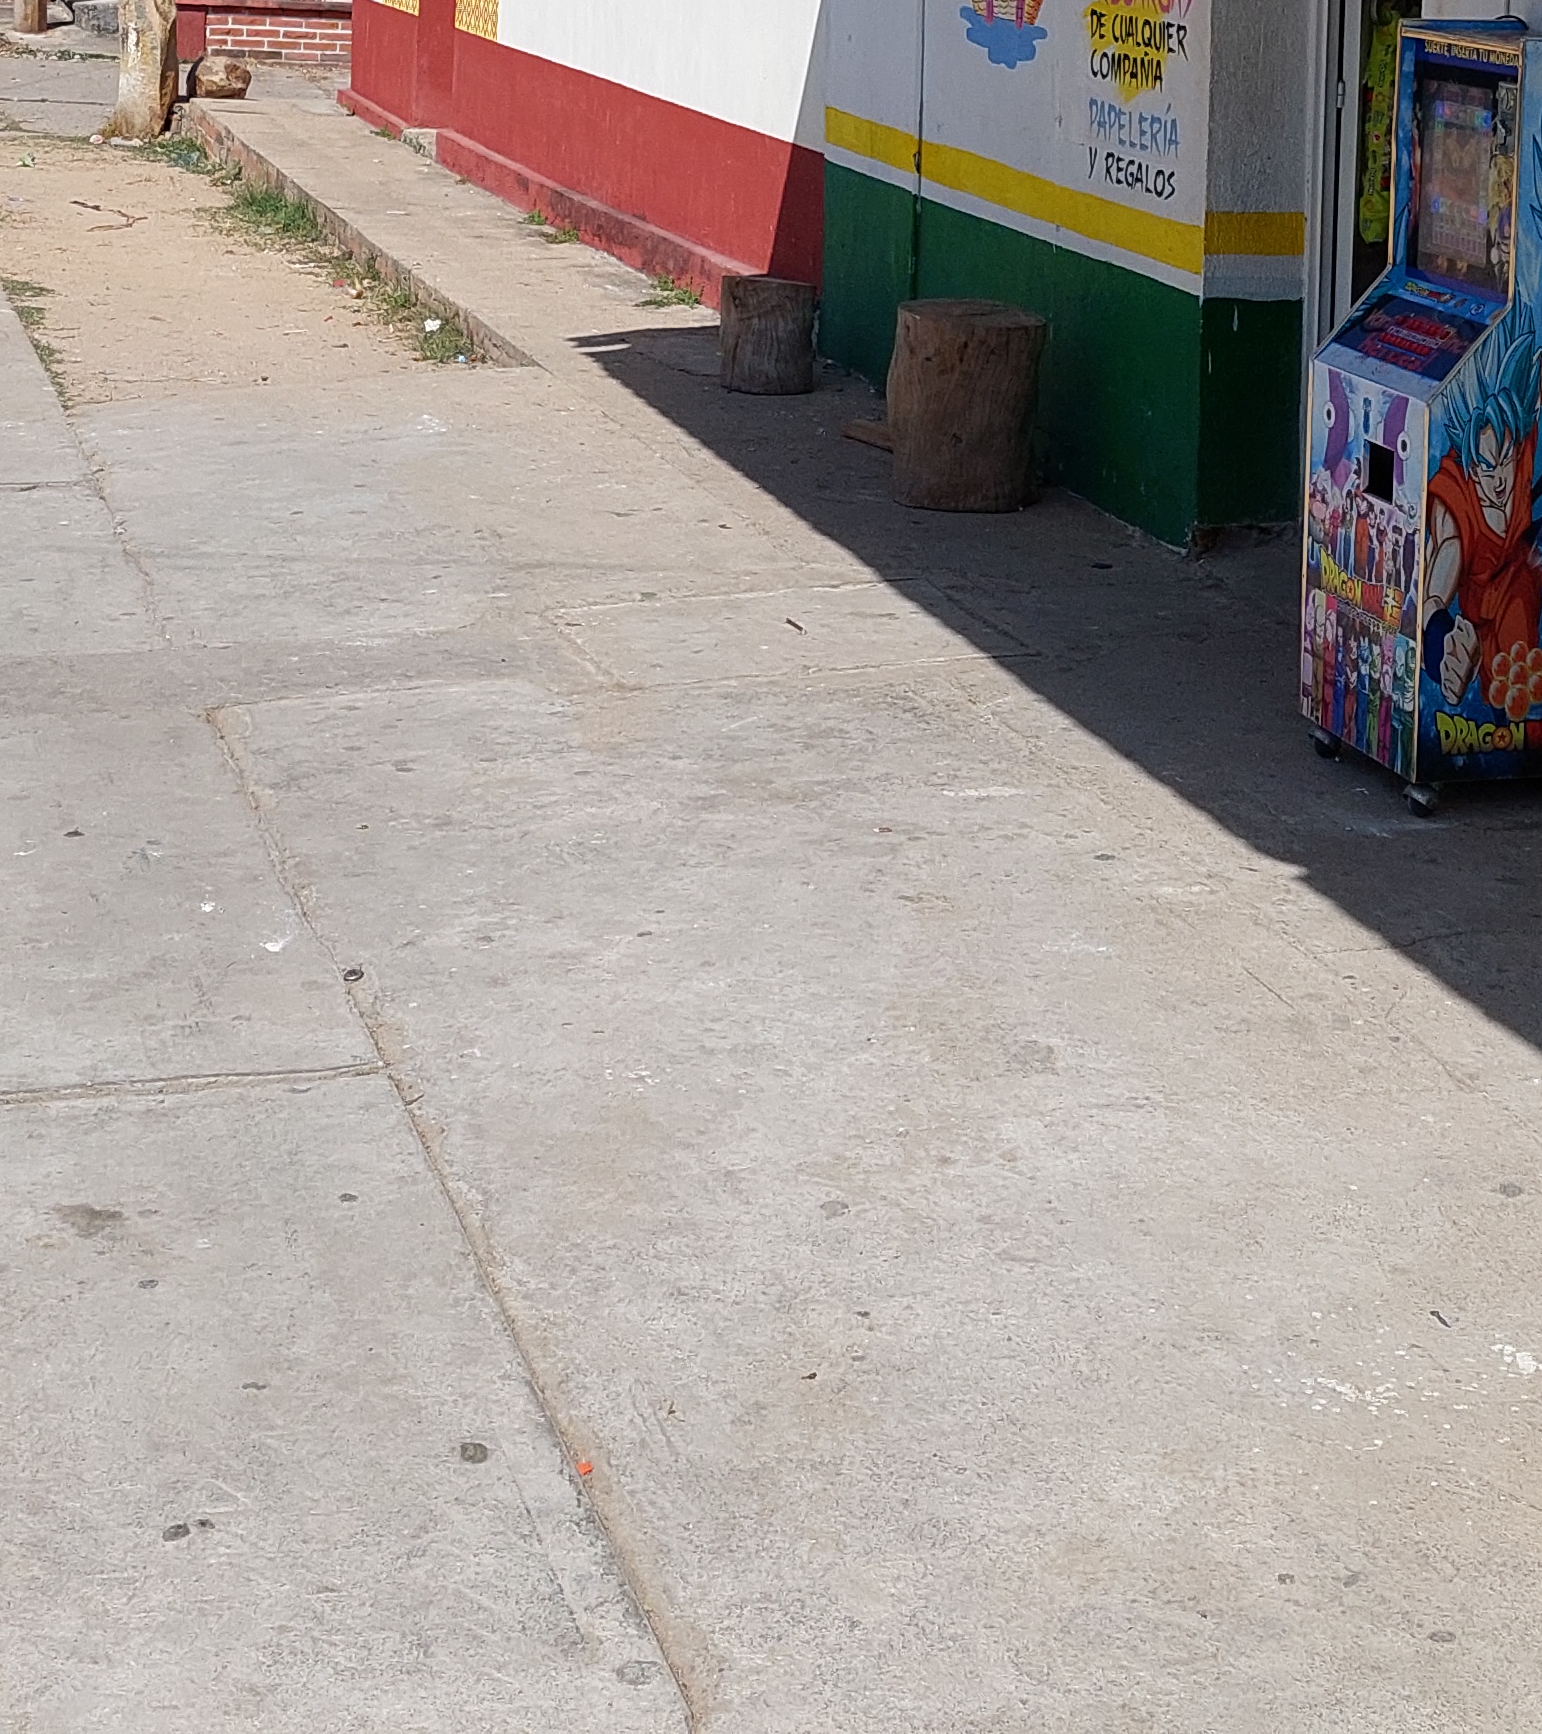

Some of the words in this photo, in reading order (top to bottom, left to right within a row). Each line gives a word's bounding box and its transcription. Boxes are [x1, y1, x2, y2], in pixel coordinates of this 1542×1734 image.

[1089, 7, 1107, 41] DE
[1111, 13, 1189, 62] CUALQUIER
[1479, 47, 1489, 63] TU
[1489, 50, 1519, 67] MONEDA
[1089, 48, 1164, 94] COMPAÑIA
[1088, 97, 1181, 158] PAPELERÍA
[1087, 145, 1098, 180] Y
[1104, 150, 1176, 201] REGALOS
[1320, 546, 1363, 610] DRAGON
[1435, 711, 1526, 756] DRAGON
